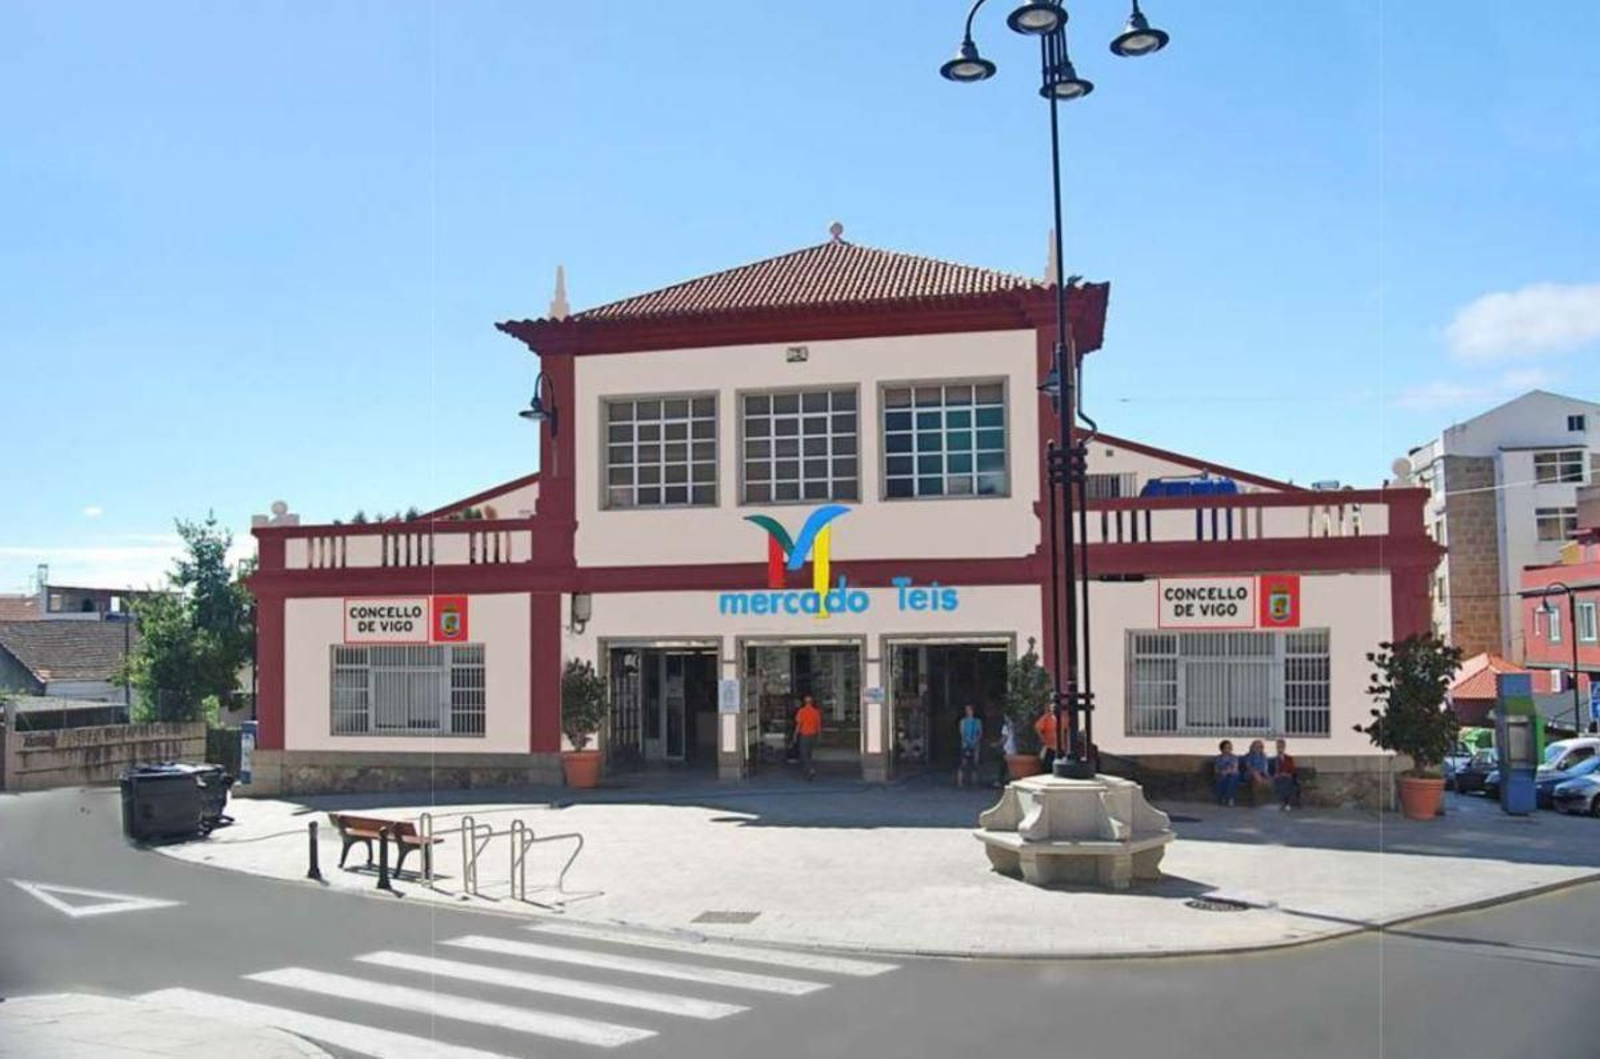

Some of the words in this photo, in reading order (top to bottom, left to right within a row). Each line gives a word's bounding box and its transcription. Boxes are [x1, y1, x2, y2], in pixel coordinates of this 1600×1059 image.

[719, 575, 870, 615] mercado
[891, 576, 959, 612] Teis
[1164, 587, 1248, 601] CONCELLO
[349, 606, 422, 618] CONCELLO
[1174, 604, 1194, 617] DE
[1200, 603, 1238, 616] VIGO
[357, 621, 375, 632] DE
[380, 621, 413, 632] VIGO
